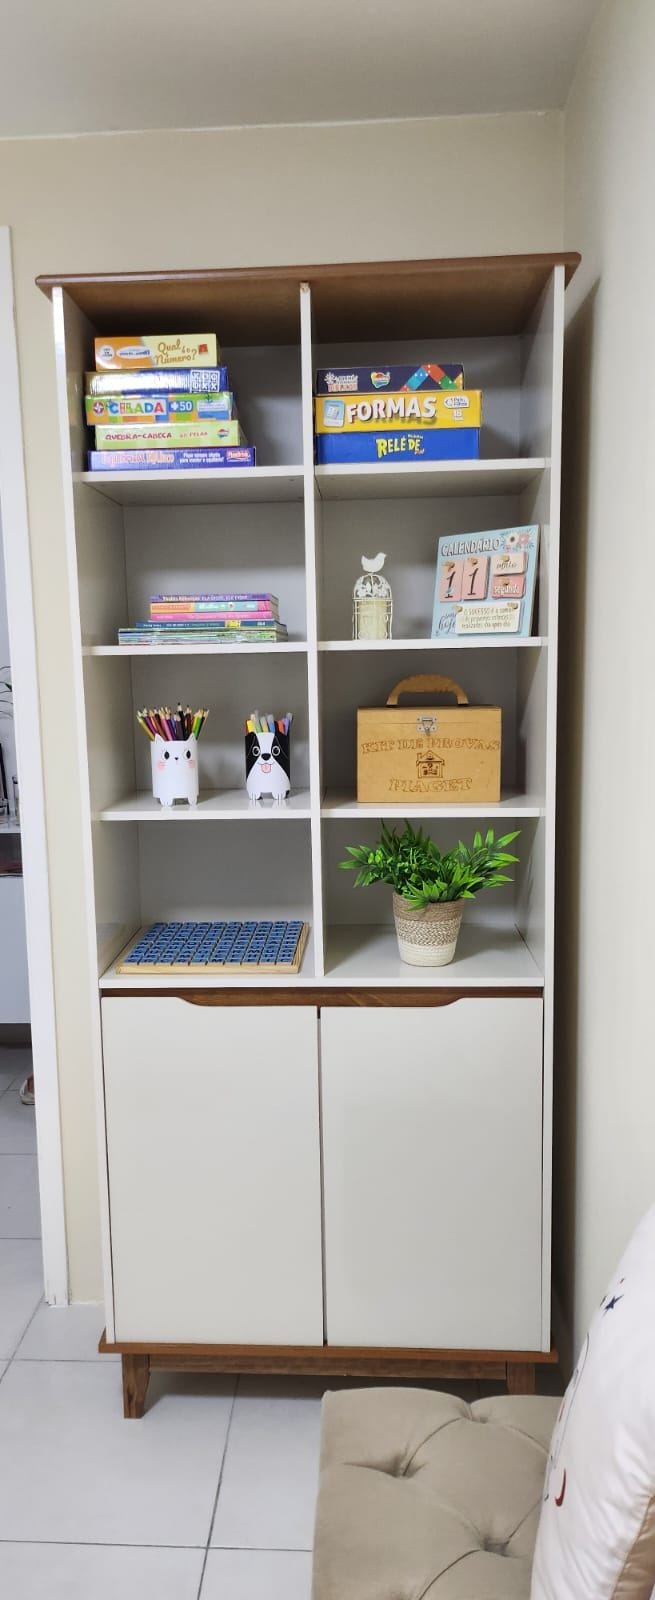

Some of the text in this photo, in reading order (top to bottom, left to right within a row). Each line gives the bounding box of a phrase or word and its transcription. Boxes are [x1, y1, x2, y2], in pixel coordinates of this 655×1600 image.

[158, 338, 181, 355] Qual
[108, 399, 165, 414] CILADA
[346, 395, 436, 423] FORMAS
[467, 567, 479, 596] 1
